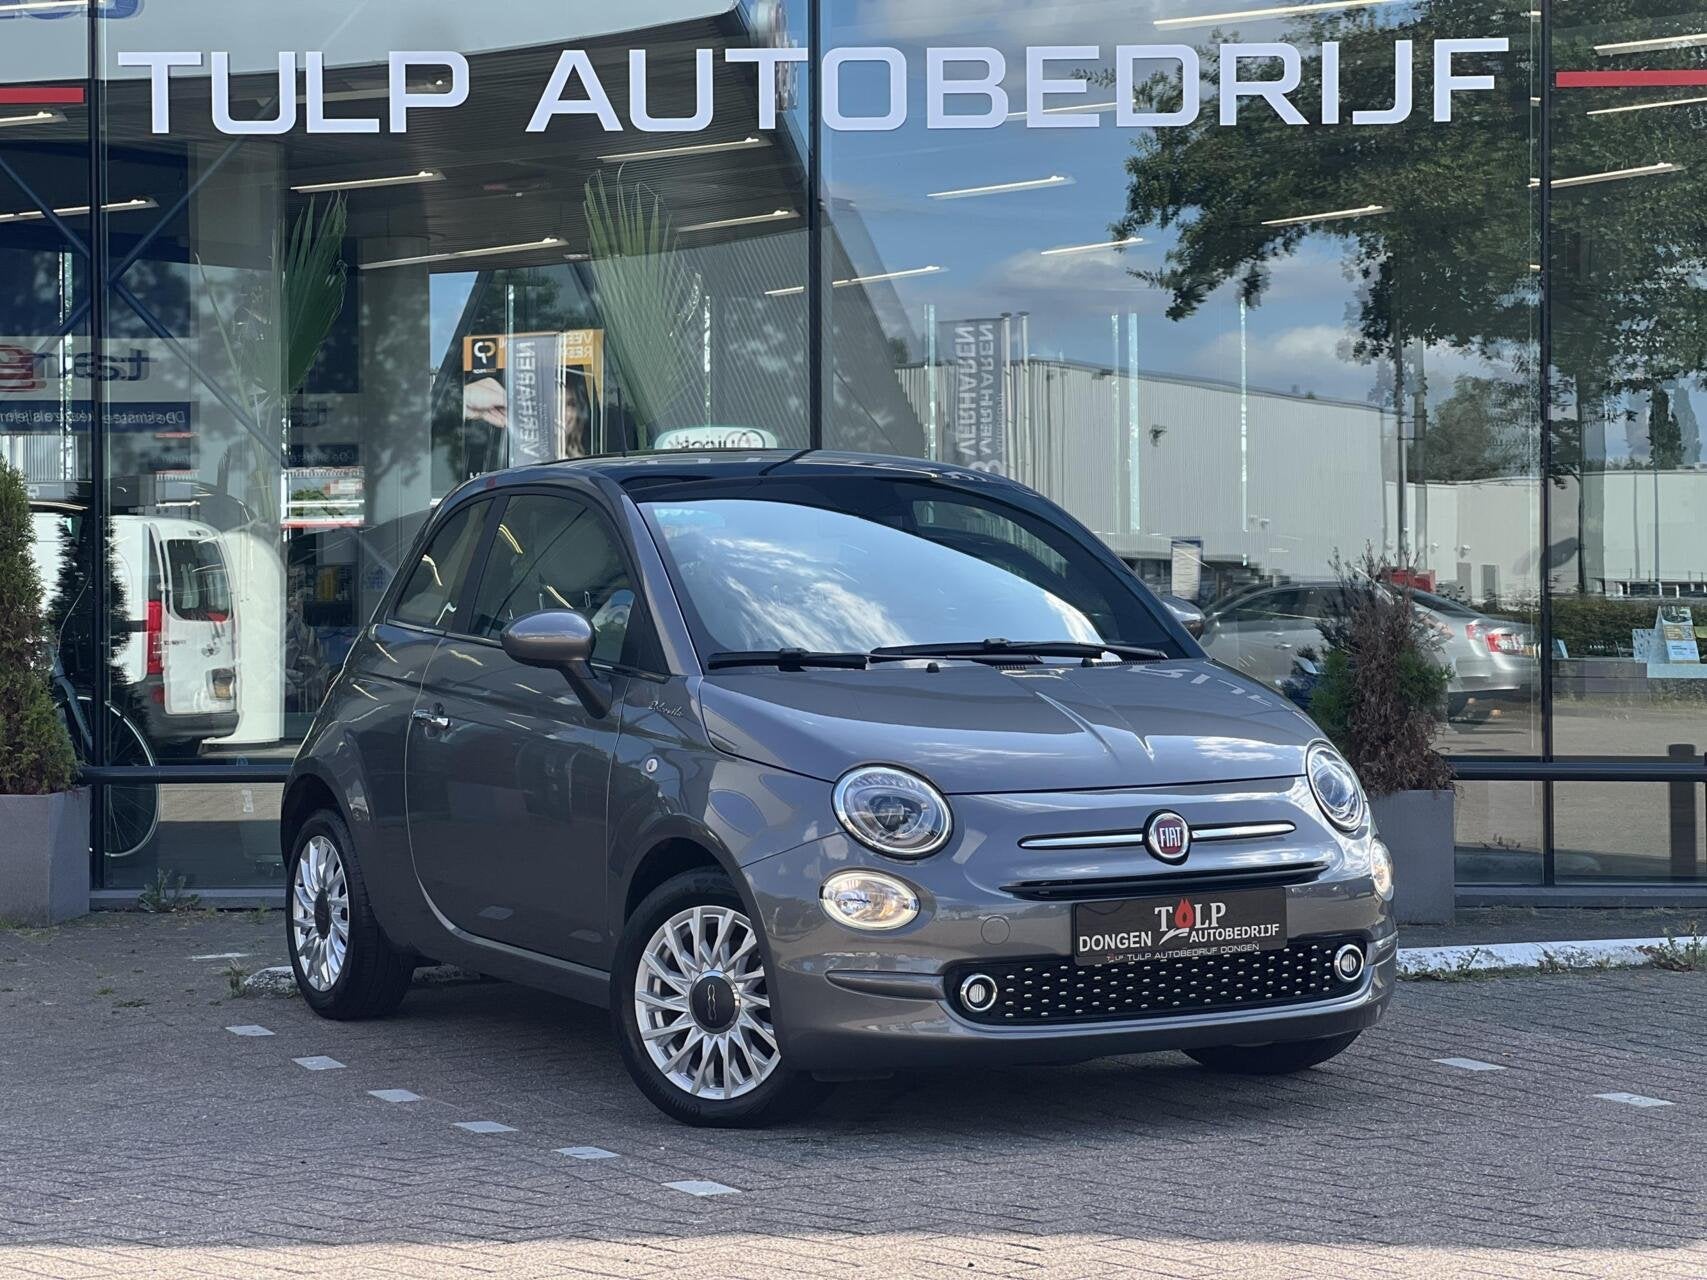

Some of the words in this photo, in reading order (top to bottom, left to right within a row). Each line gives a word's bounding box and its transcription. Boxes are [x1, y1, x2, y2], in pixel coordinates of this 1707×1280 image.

[118, 50, 470, 135] TULP
[525, 38, 1510, 134] AUTOBEDRIJF
[1160, 826, 1181, 847] FIAT
[1079, 931, 1152, 952] DONGEN
[1189, 923, 1280, 943] AUTOBEDRIJF
[1127, 952, 1151, 961] TULP
[1154, 946, 1218, 960] AUTOBEDRIJF
[1221, 943, 1260, 954] DONGEN
